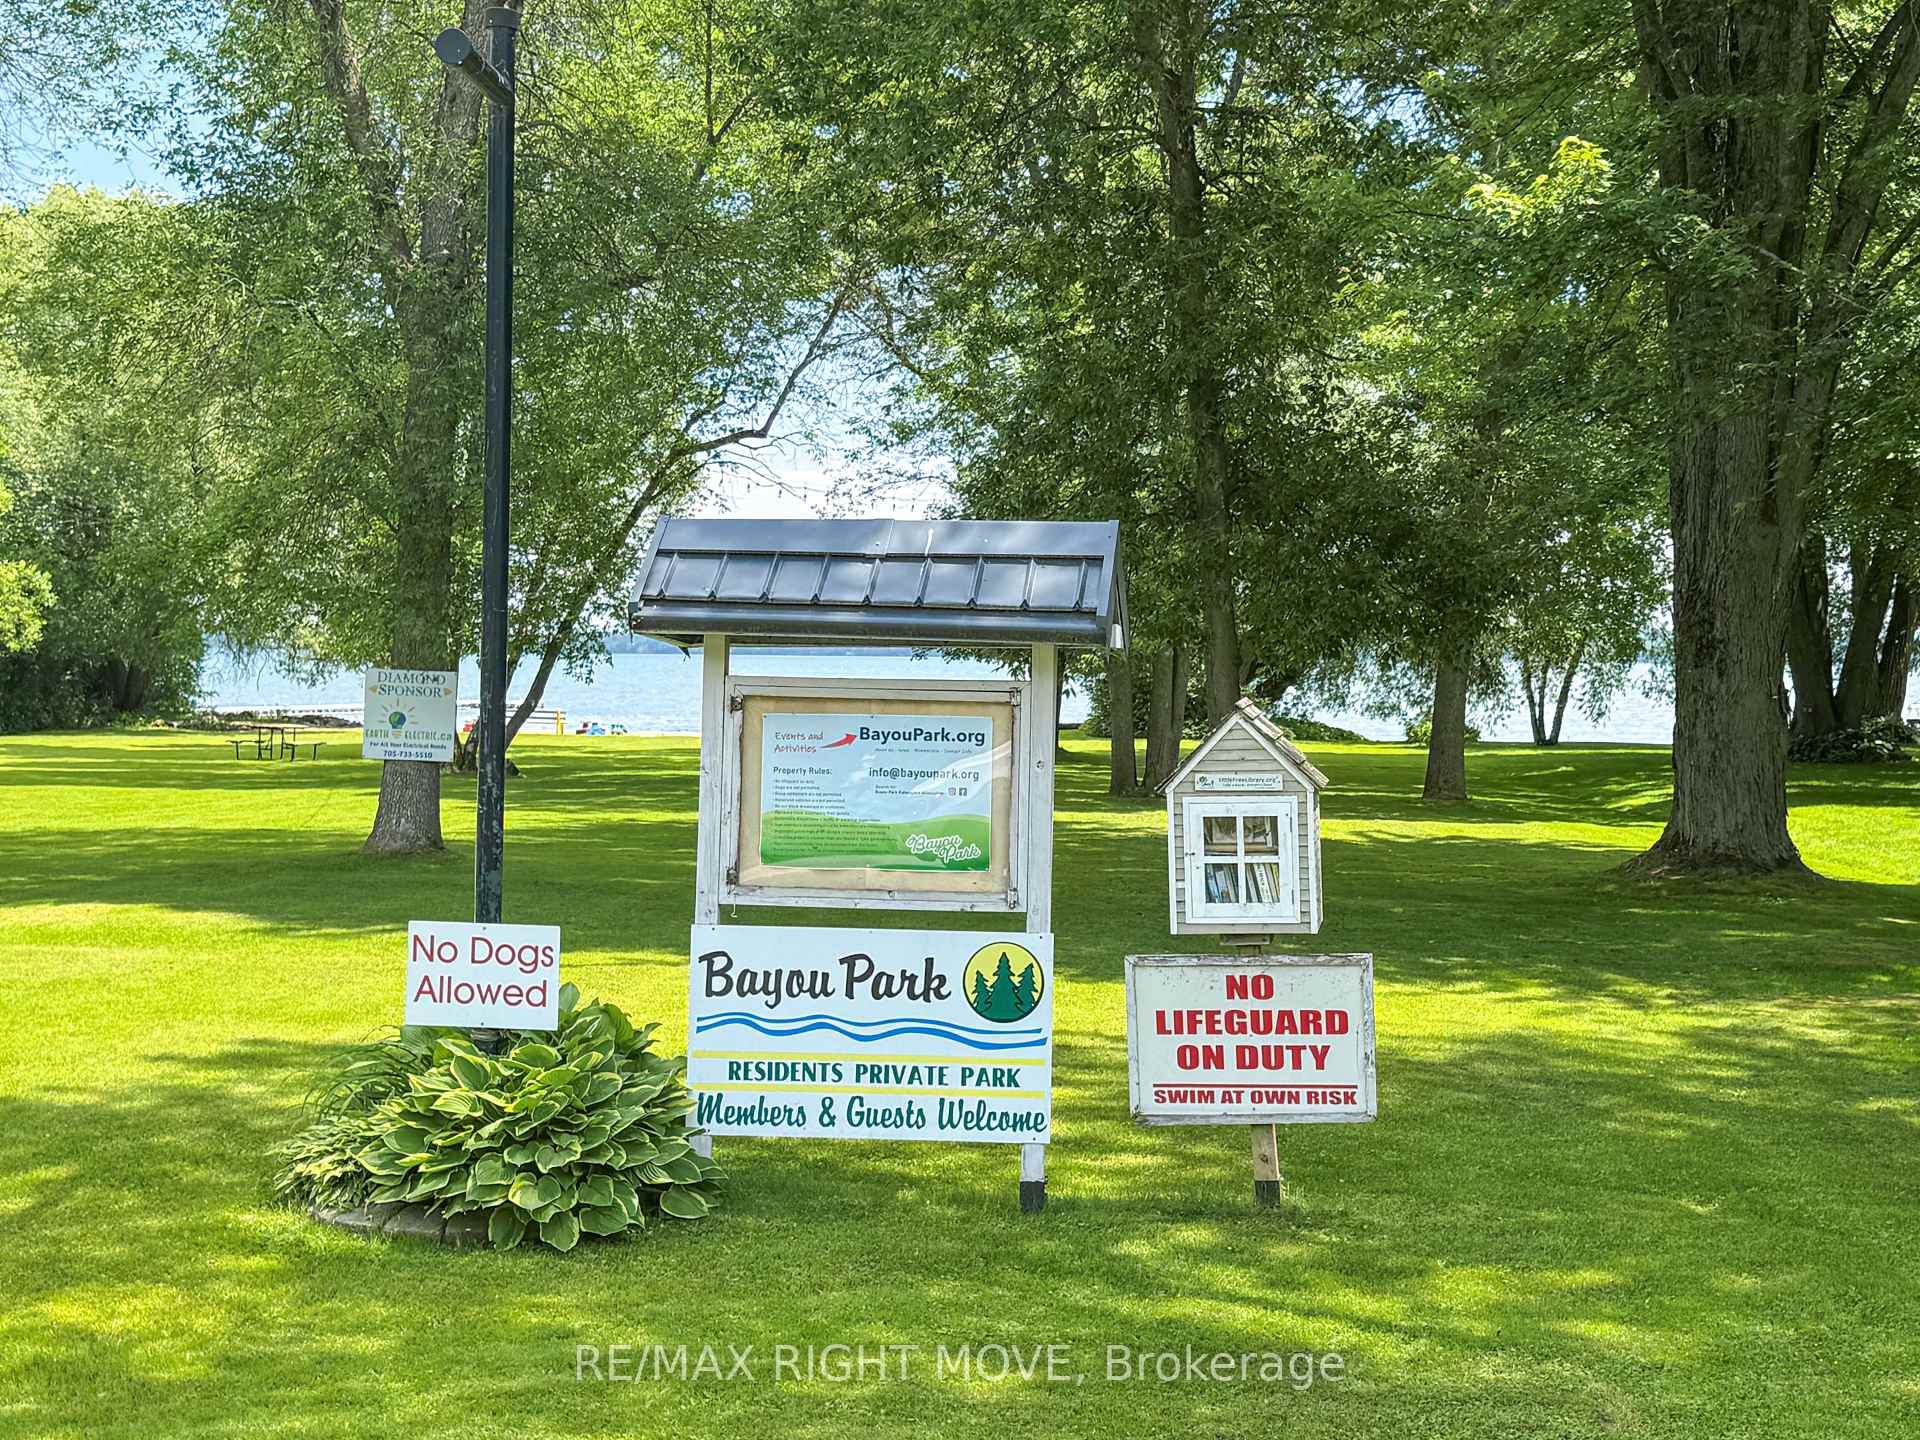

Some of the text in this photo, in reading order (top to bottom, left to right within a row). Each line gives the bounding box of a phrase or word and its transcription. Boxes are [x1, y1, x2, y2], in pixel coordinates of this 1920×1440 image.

[377, 671, 446, 685] DIAMOND
[378, 684, 442, 698] SPONSOR
[775, 731, 824, 741] Events and
[859, 727, 985, 746] BayouPark.org
[774, 743, 817, 753] Activities
[773, 767, 833, 777] Property Rules:
[869, 767, 980, 782] info@bayoupark.org
[906, 834, 962, 854] Bayou
[938, 843, 981, 864] Park
[412, 934, 554, 974] No Dogs
[698, 950, 952, 1009] Bayou Park
[1225, 974, 1274, 1000] NO
[413, 975, 547, 1008] Allowed
[1155, 1009, 1349, 1035] LIFEGUARD
[1176, 1044, 1331, 1070] ON DUTY
[728, 1060, 1021, 1088] RESIDENTS PRIVATE PARK
[1154, 1089, 1358, 1105] SWIM AT OWN RISK
[696, 1092, 1047, 1133] Members & Guests Welcome
